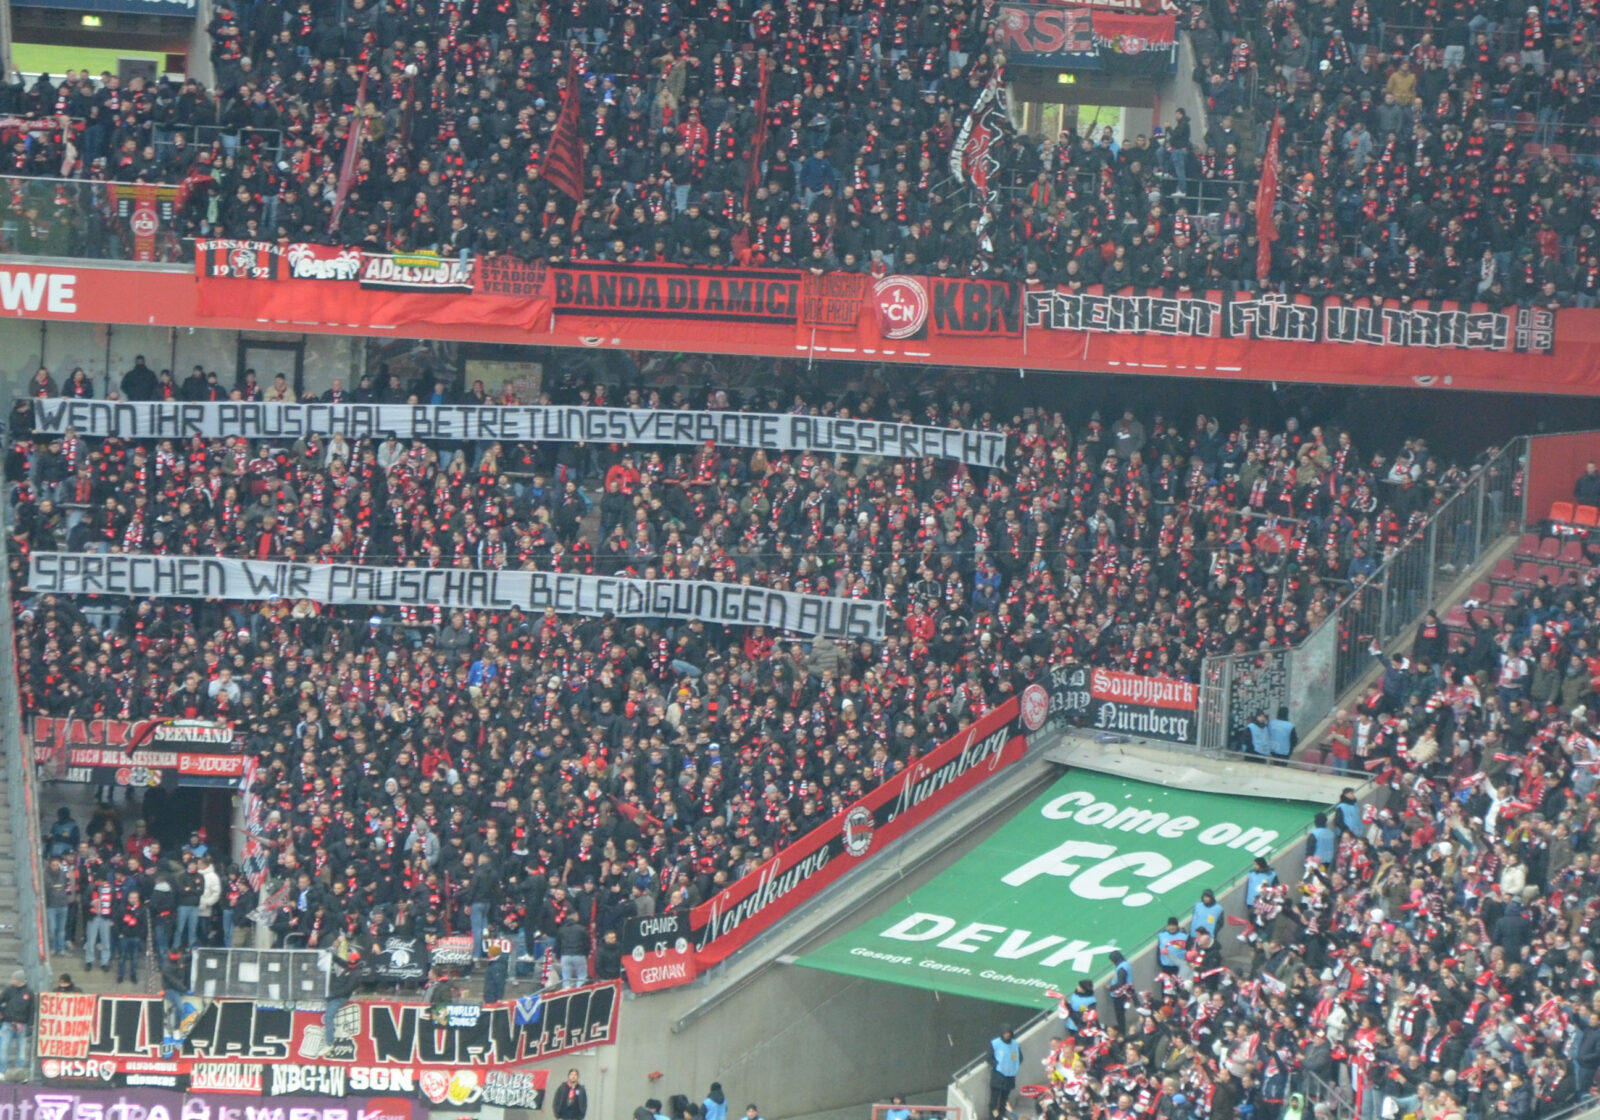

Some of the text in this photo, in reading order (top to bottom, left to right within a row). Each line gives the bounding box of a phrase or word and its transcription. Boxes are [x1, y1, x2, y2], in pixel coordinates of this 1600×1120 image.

[1003, 9, 1091, 52] RSE
[196, 240, 287, 257] WEISSACHTAL
[213, 265, 270, 278] 19 92
[365, 257, 474, 284] ADELSDORF
[481, 270, 547, 284] STADION
[483, 281, 542, 295] VERBOT
[555, 271, 798, 318] BANDA DI AMICI
[893, 289, 905, 303] 1.
[933, 281, 1020, 334] KBN
[1026, 290, 1509, 349] FREIHEIT FÜR ULTRAS!
[36, 404, 136, 440] WENN
[149, 404, 201, 441] IHR
[218, 404, 384, 440] PAUSCHAL
[411, 406, 779, 448] BETRETUNGSVERBOTE
[35, 554, 885, 641] SPRECHEN WIR PAUSCHAL BELEIDIGUNGEN AUS!
[34, 716, 152, 747] FIASKO
[154, 725, 233, 744] SEENLAND
[1095, 702, 1189, 742] Nürnberg
[888, 727, 1010, 823] Nürnberg
[1040, 791, 1279, 858] Come on,
[1000, 839, 1215, 908] FC!
[696, 844, 830, 953] Nordkurve
[640, 916, 678, 937] CHAMPS
[878, 911, 1122, 974] DEVK
[640, 962, 686, 984] GERMANY
[849, 946, 1062, 993] Gesagt. Getan. Geholfen.
[39, 996, 94, 1017] SEKTION
[39, 1019, 91, 1038] STADION
[39, 1039, 89, 1057] VERBOT
[60, 1060, 98, 1078] KSR
[350, 1066, 414, 1092] SGN
